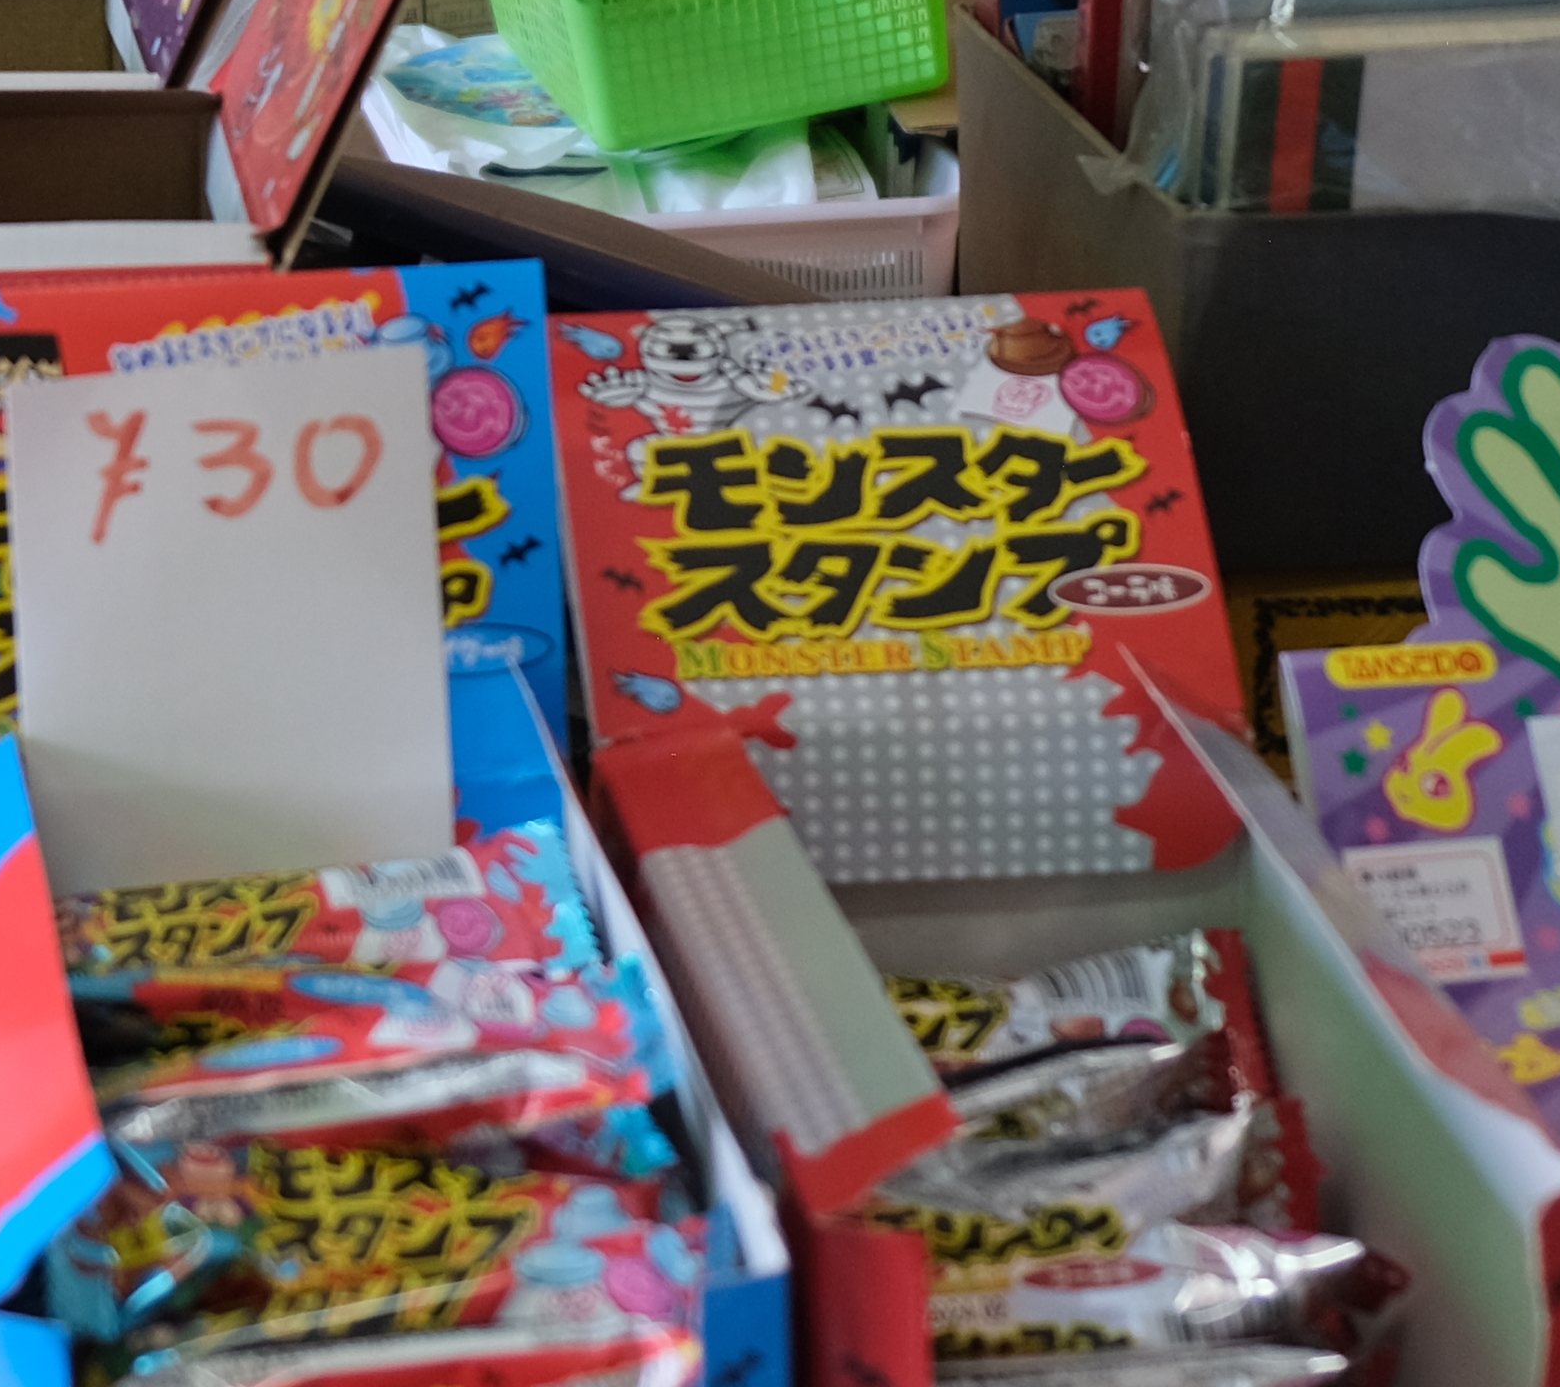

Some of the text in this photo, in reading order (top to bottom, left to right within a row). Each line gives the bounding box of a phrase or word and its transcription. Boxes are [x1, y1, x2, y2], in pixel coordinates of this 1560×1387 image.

[86, 408, 385, 546] ¥30
[642, 427, 1148, 533] モンスター
[642, 512, 1140, 639] スタンプ
[1083, 573, 1179, 606] コーラ味
[678, 627, 1089, 679] MONSTER STAMP
[1340, 649, 1484, 679] TANSEIDO
